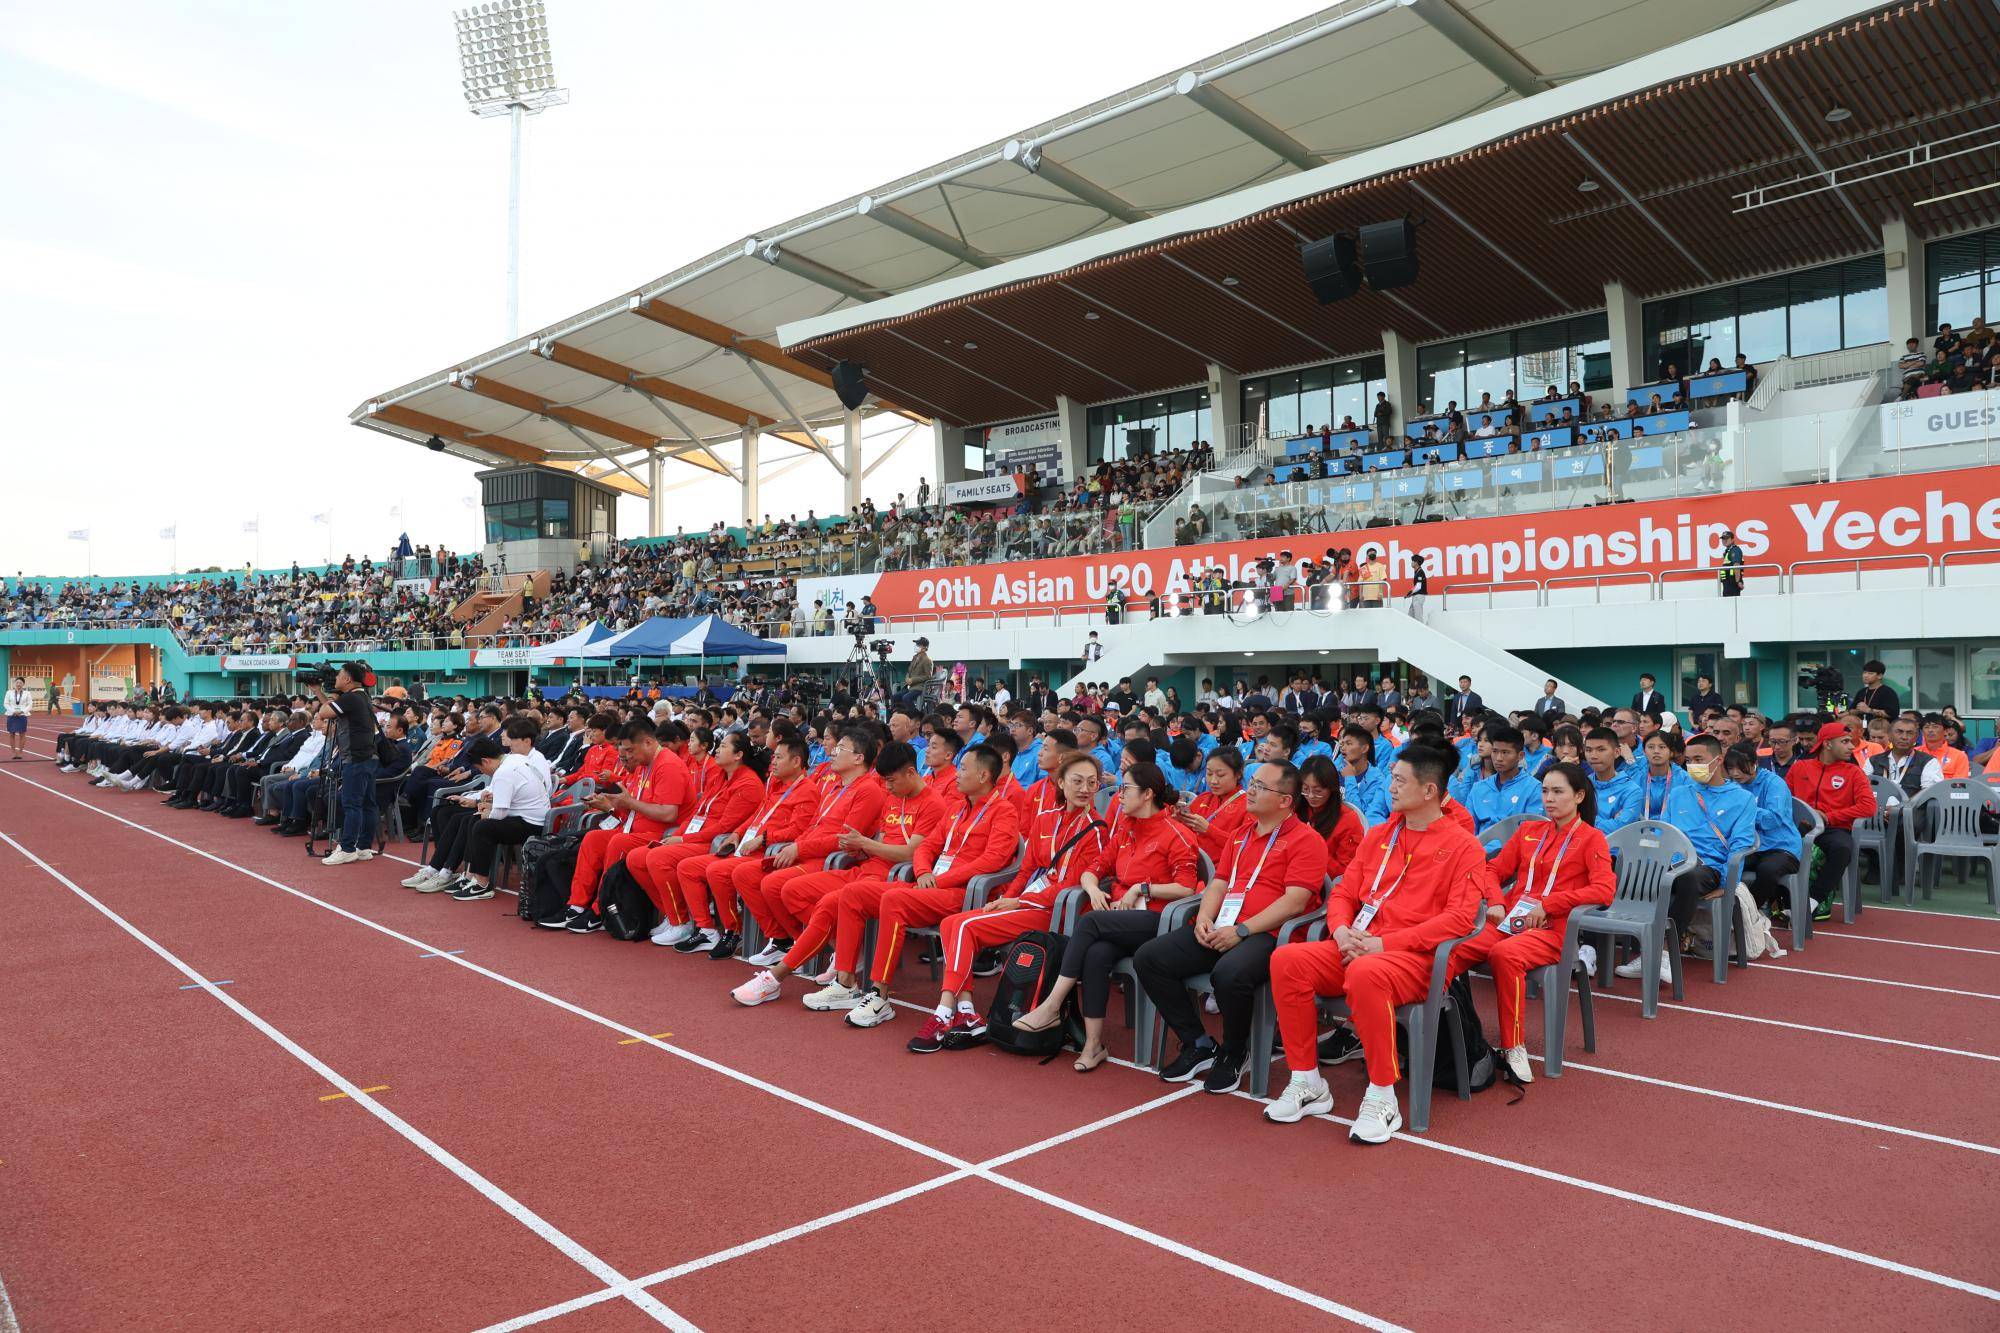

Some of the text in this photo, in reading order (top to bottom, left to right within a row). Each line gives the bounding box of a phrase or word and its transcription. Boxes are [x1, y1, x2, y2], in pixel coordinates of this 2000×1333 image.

[1927, 405, 2000, 432] GUES
[1511, 468, 1522, 479] 예
[1572, 460, 1584, 474] 천
[957, 487, 985, 498] FAMILY
[986, 484, 1011, 494] SEATS
[918, 576, 981, 609] 20th
[990, 571, 1074, 605] Asian
[1085, 562, 1153, 600] U20
[1164, 550, 1334, 595] Athlec
[1356, 513, 1770, 582] Championships
[497, 650, 530, 659] TEAM SEAT
